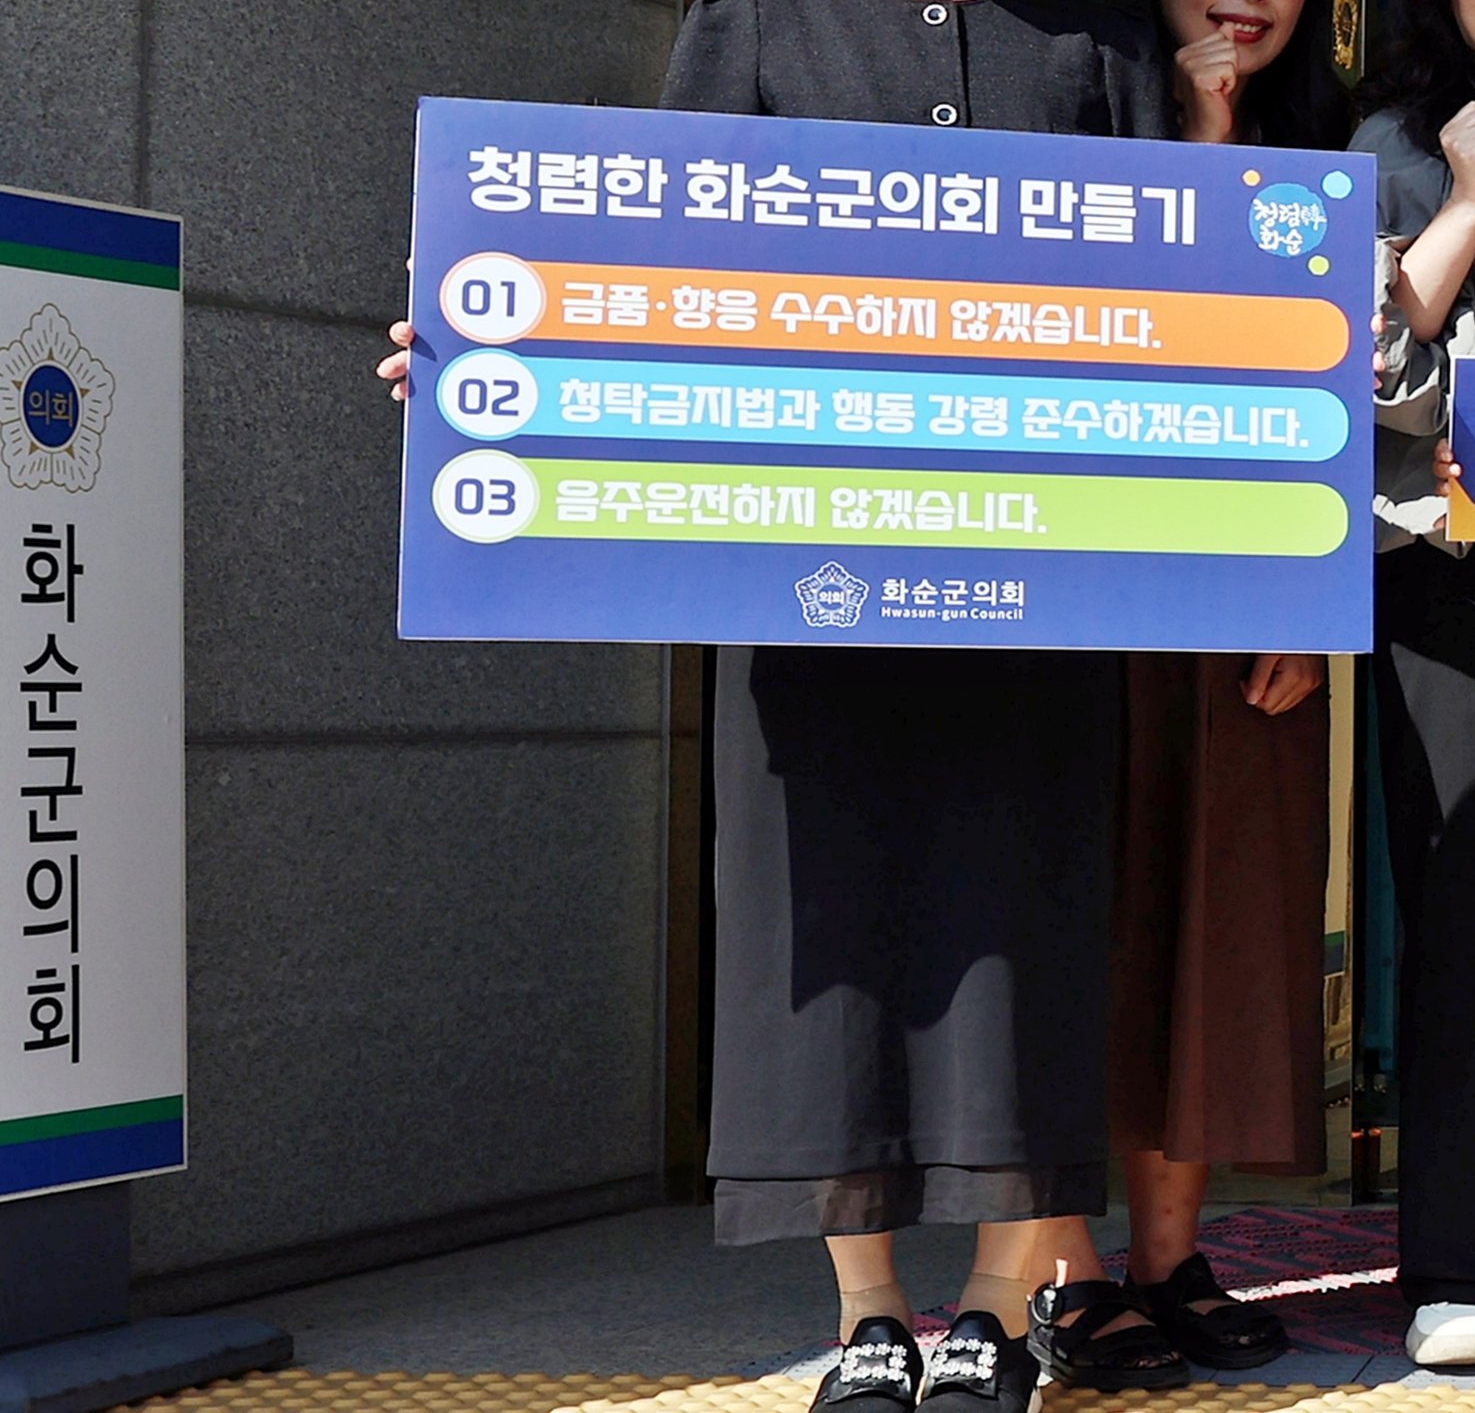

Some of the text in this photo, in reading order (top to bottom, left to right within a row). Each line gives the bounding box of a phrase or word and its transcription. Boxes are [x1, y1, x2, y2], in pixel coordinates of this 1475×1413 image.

[468, 144, 1198, 245] 청렴한 화순군의회 만들기
[1258, 225, 1303, 255] 화순
[462, 279, 518, 318] 01
[770, 291, 937, 340] 수수하지
[951, 299, 1163, 351] 않겠습니다.
[28, 390, 73, 426] 의회
[457, 377, 1310, 450] 02 청탁금지법과 행동 강령 준수하겠습니다.
[453, 476, 1047, 535] 03 음주운전하지 않겠습니다.
[881, 578, 1025, 607] 화순군의회
[881, 608, 1023, 622] Hwasun-gun Council
[20, 523, 84, 1063] 화순군의회
